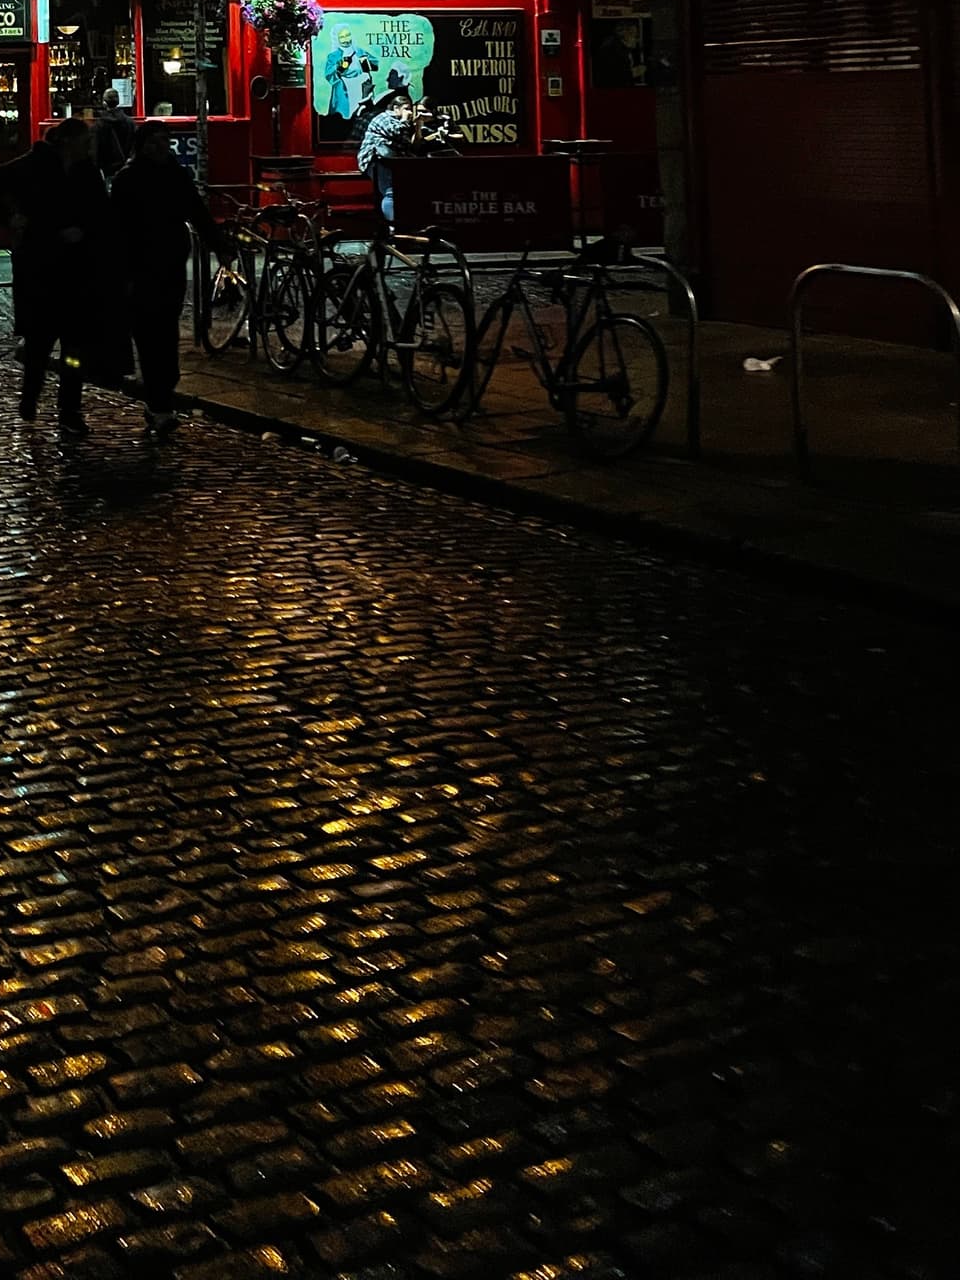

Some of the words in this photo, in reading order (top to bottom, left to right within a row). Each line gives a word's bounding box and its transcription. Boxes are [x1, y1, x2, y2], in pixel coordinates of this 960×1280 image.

[380, 20, 411, 33] THE
[365, 33, 425, 45] TEMPLE
[381, 45, 412, 58] BAR
[485, 40, 515, 58] THE
[450, 59, 516, 77] EMPEROR
[498, 77, 515, 94] OF
[462, 95, 519, 120] LIQUORS
[471, 190, 498, 201] THE
[431, 201, 499, 215] TEMPLE
[503, 201, 537, 215] BAR
